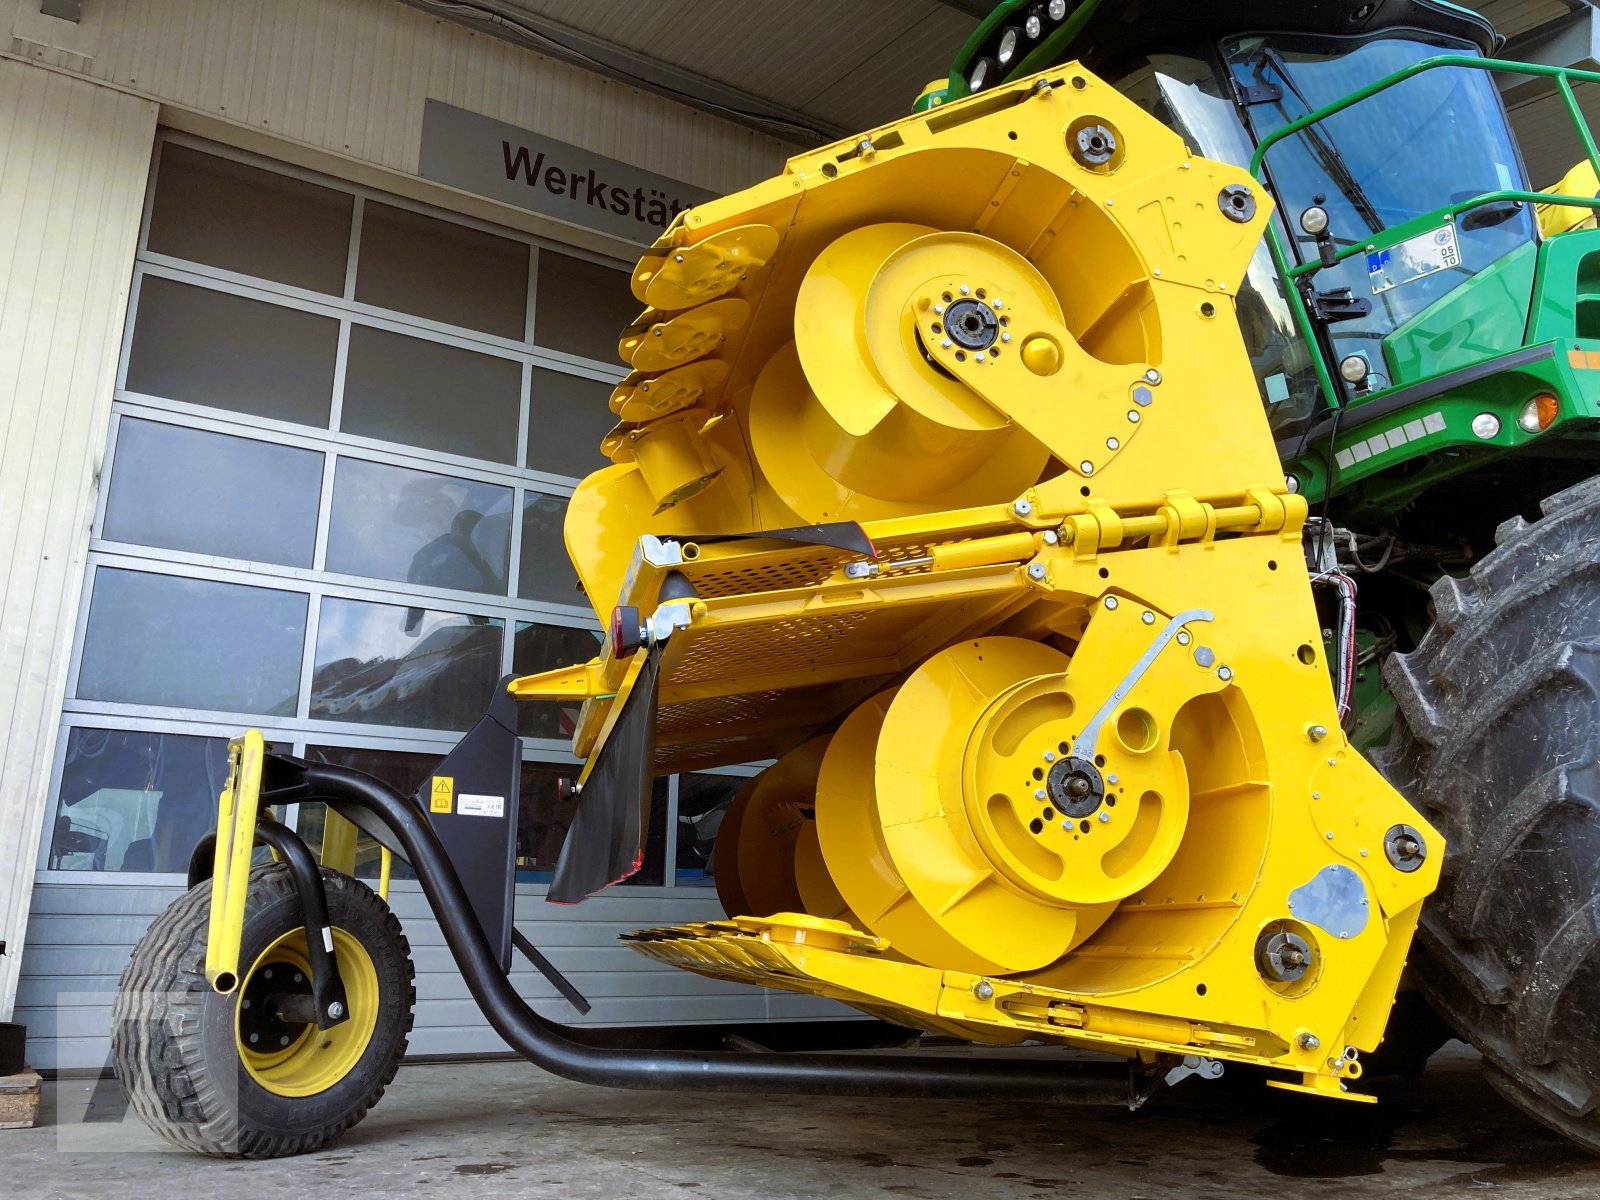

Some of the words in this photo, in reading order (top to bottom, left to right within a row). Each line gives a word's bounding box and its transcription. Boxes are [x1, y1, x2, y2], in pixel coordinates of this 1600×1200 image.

[502, 140, 693, 228] Werkstät
[1441, 245, 1454, 256] 05
[1444, 257, 1456, 267] 10
